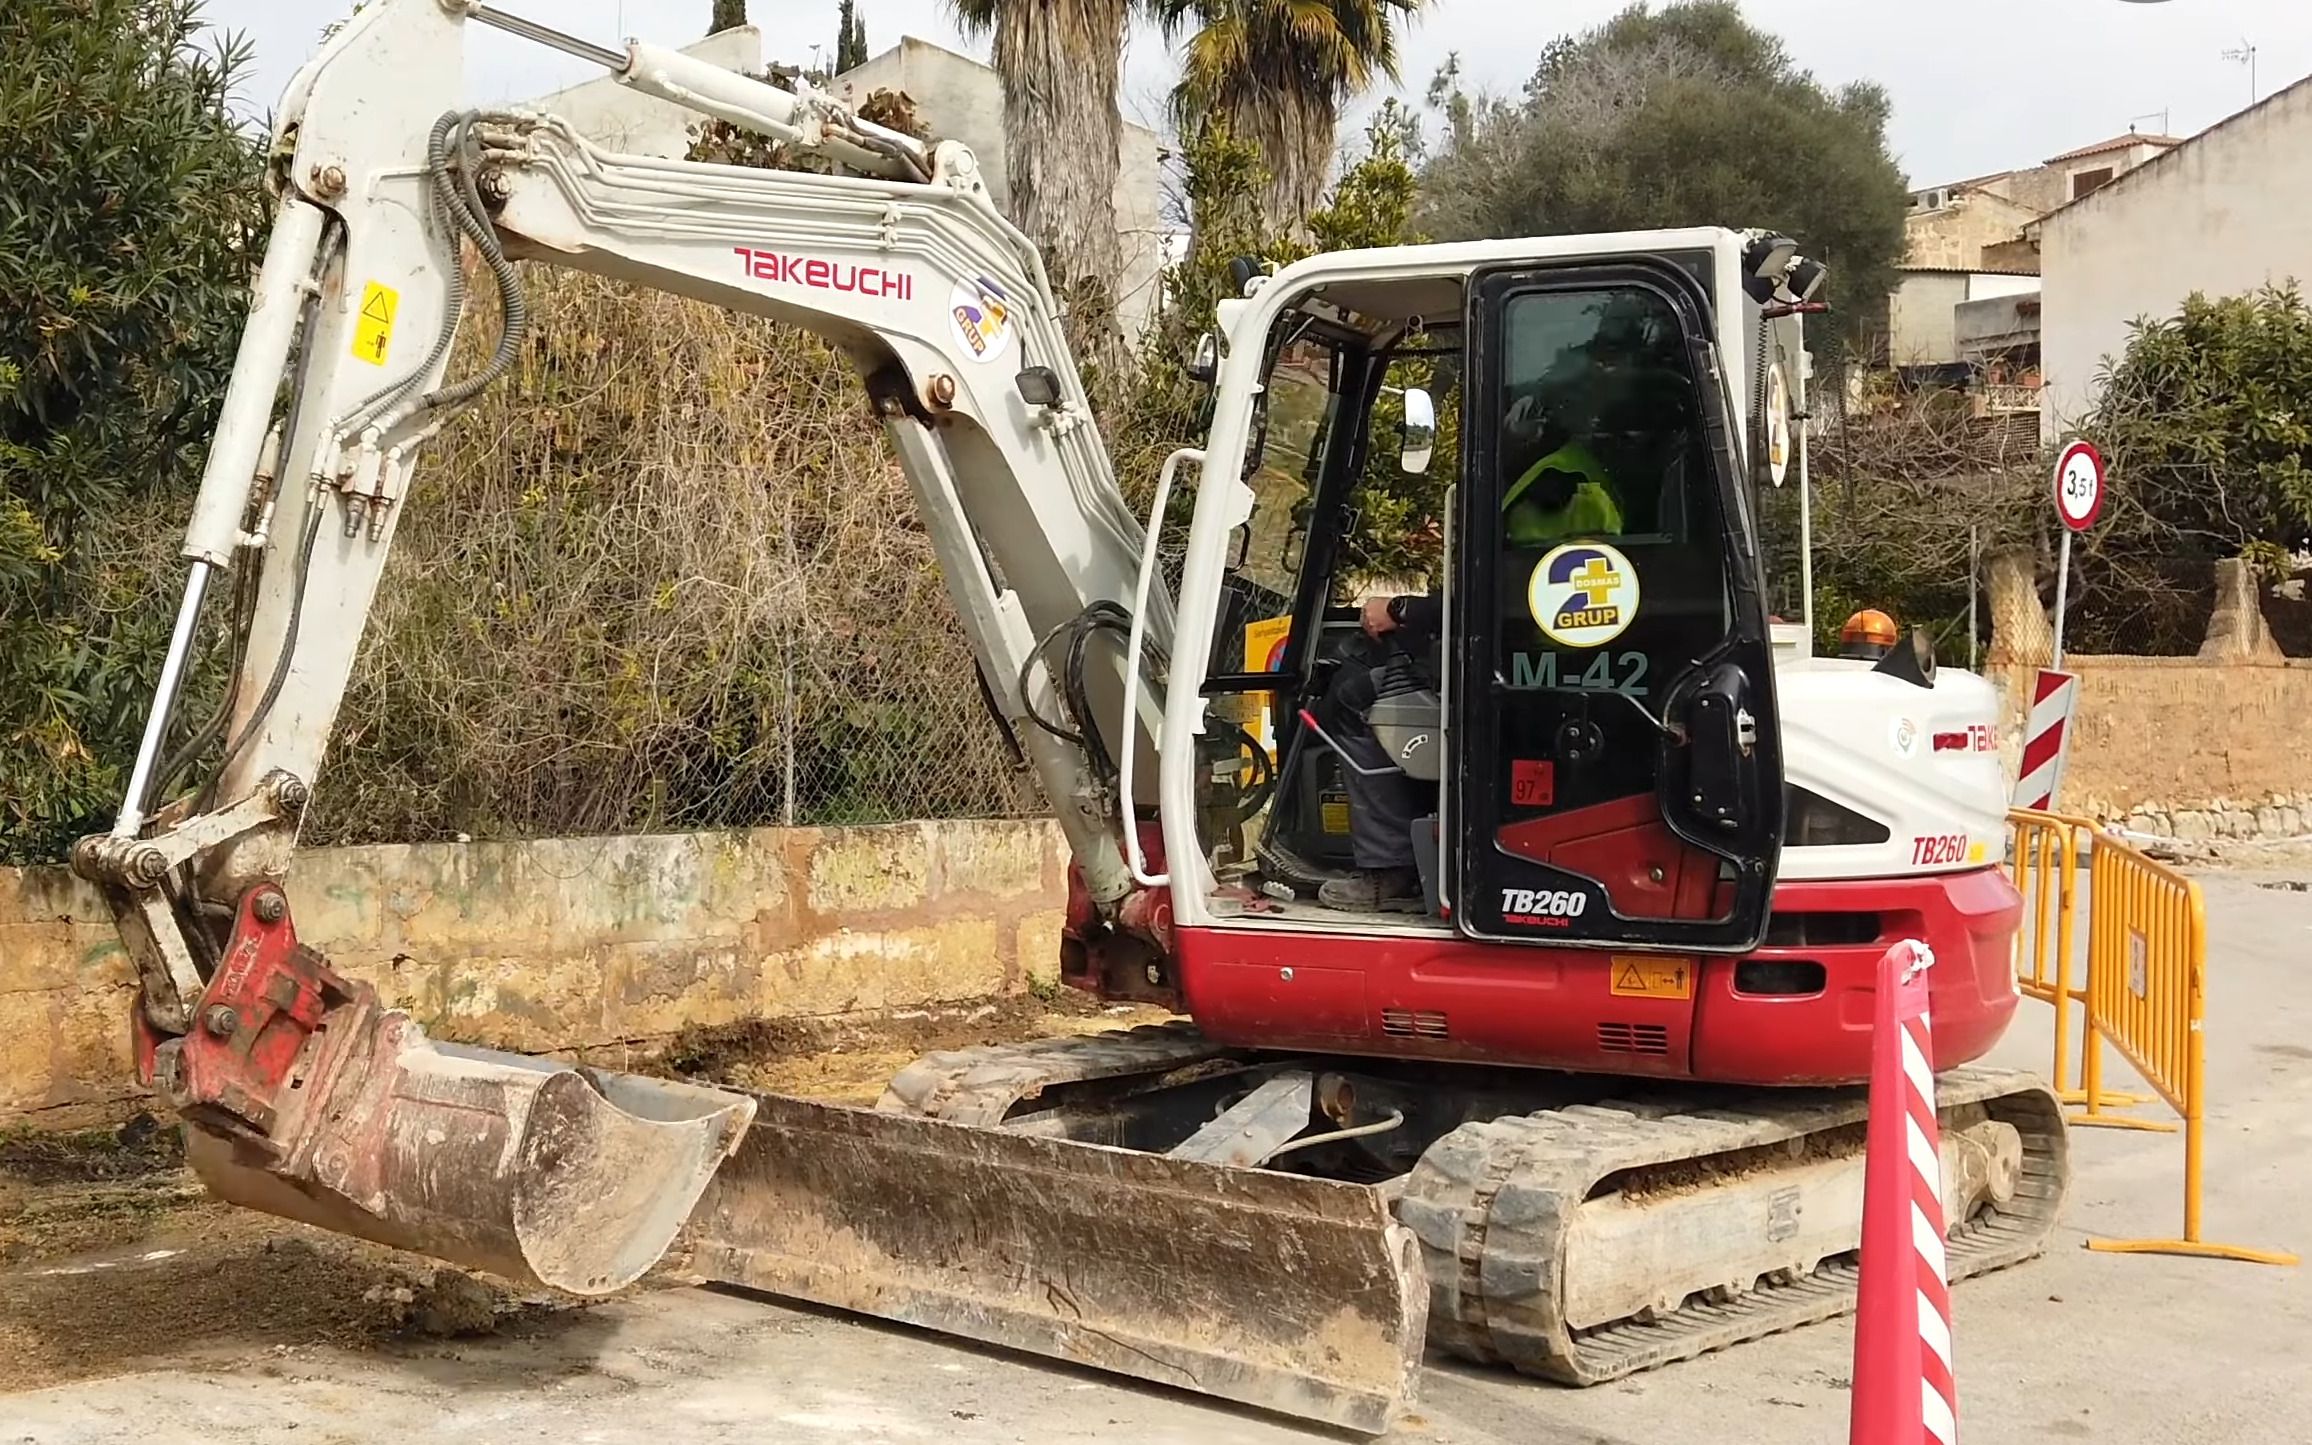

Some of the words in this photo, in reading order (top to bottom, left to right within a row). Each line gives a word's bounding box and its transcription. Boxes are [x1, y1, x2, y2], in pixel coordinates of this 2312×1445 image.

[1557, 610, 1616, 628] GRUP
[1513, 651, 1649, 696] M-42
[1516, 780, 1535, 801] 97
[1912, 834, 1967, 865] TB260
[1502, 888, 1587, 917] TB260
